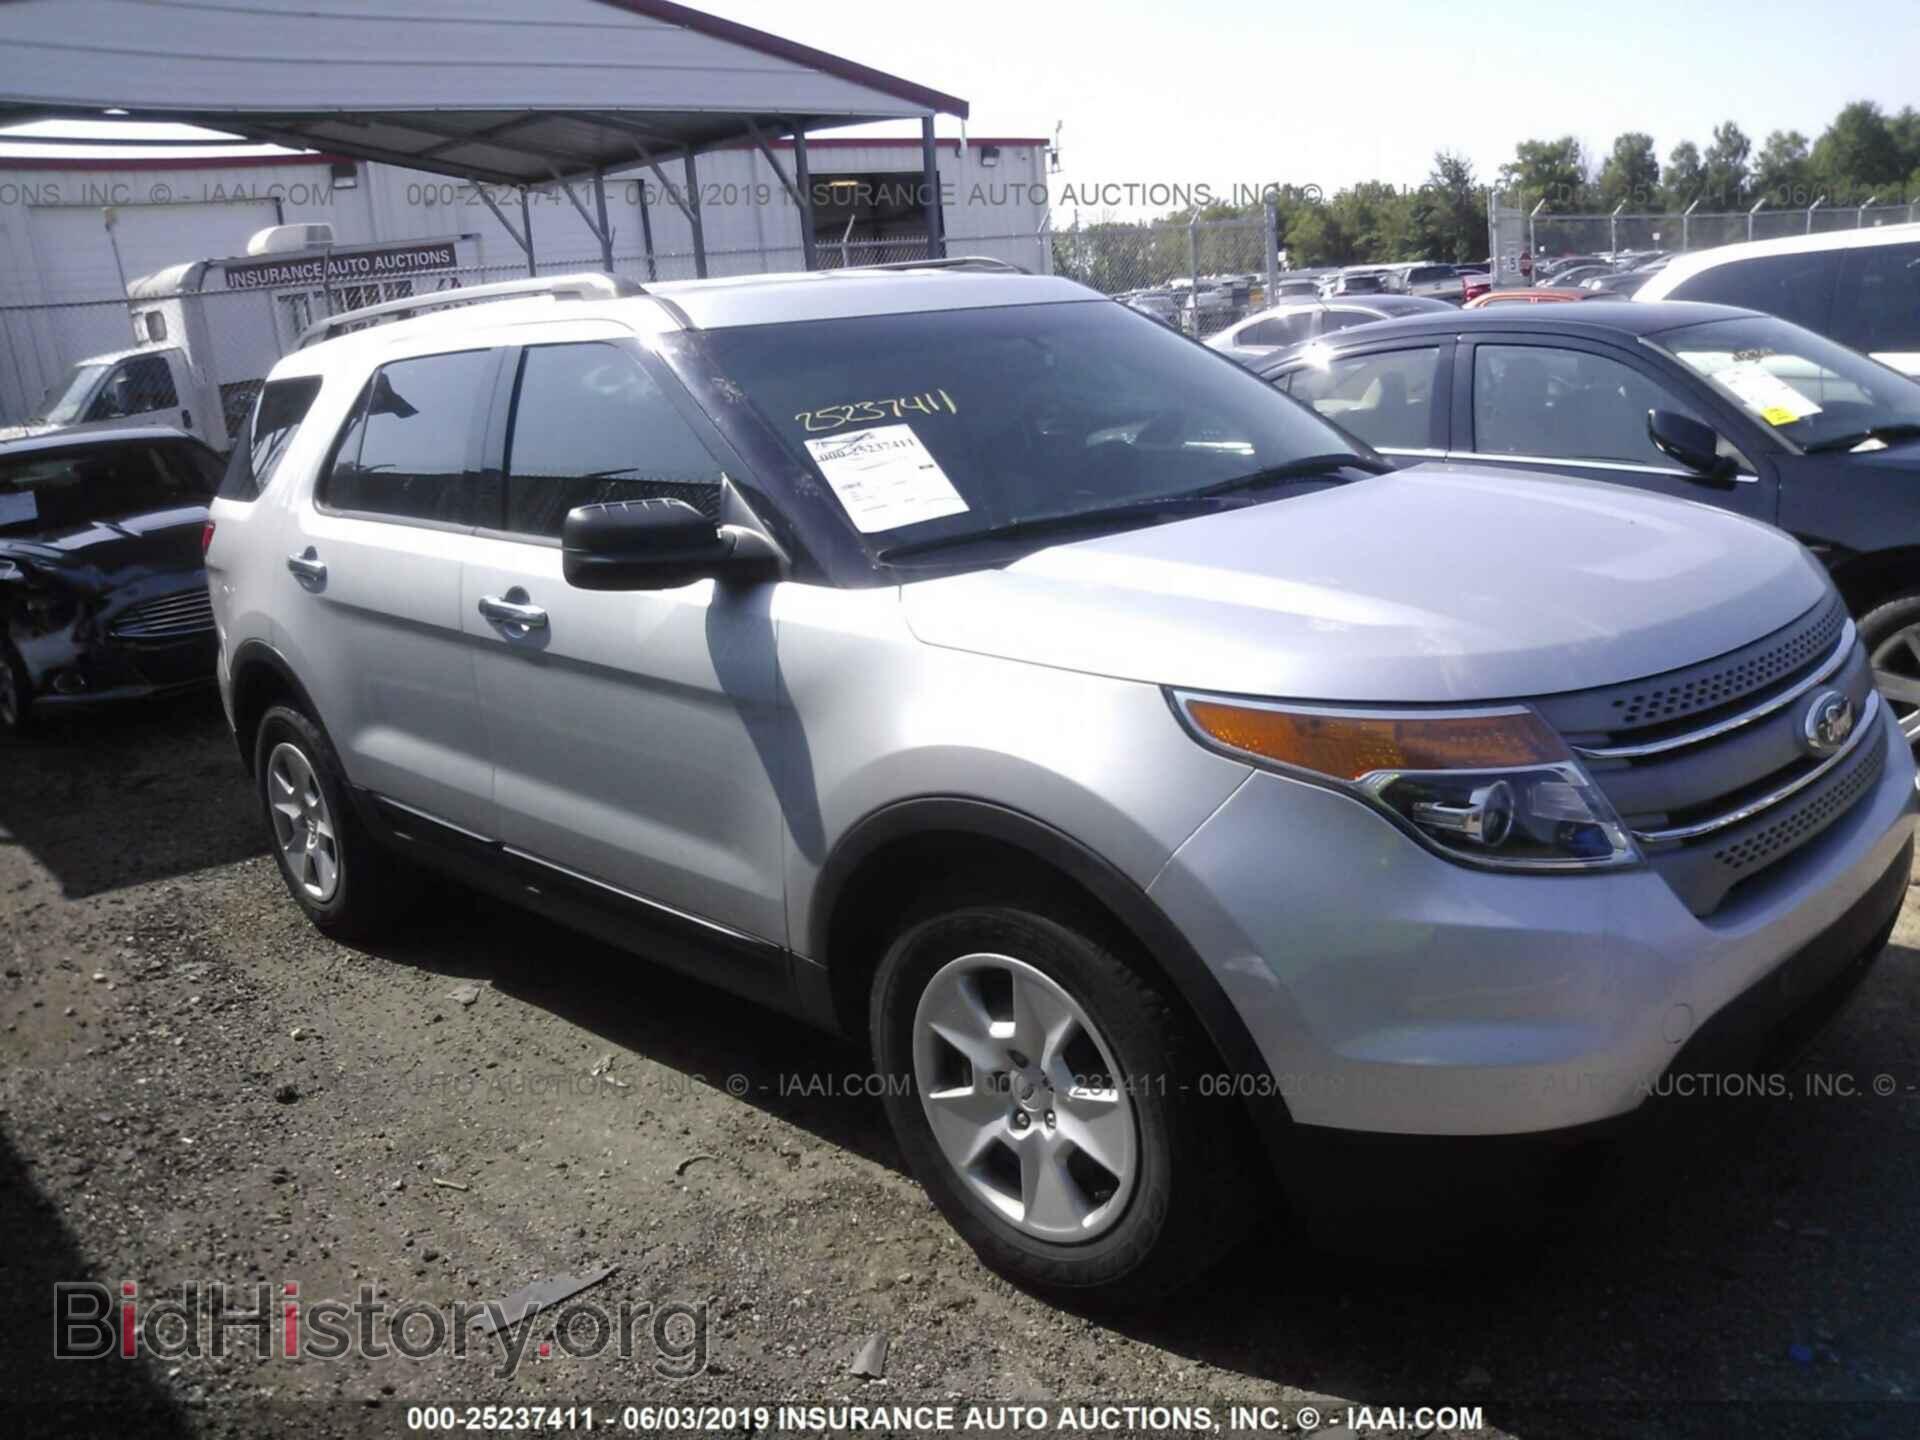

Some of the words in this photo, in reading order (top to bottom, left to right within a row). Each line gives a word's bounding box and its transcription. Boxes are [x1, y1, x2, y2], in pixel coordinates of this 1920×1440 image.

[227, 263, 322, 288] INSURANCE
[327, 257, 369, 275] AUTO
[373, 249, 450, 269] AUCTIONS
[795, 388, 957, 431] 25237411
